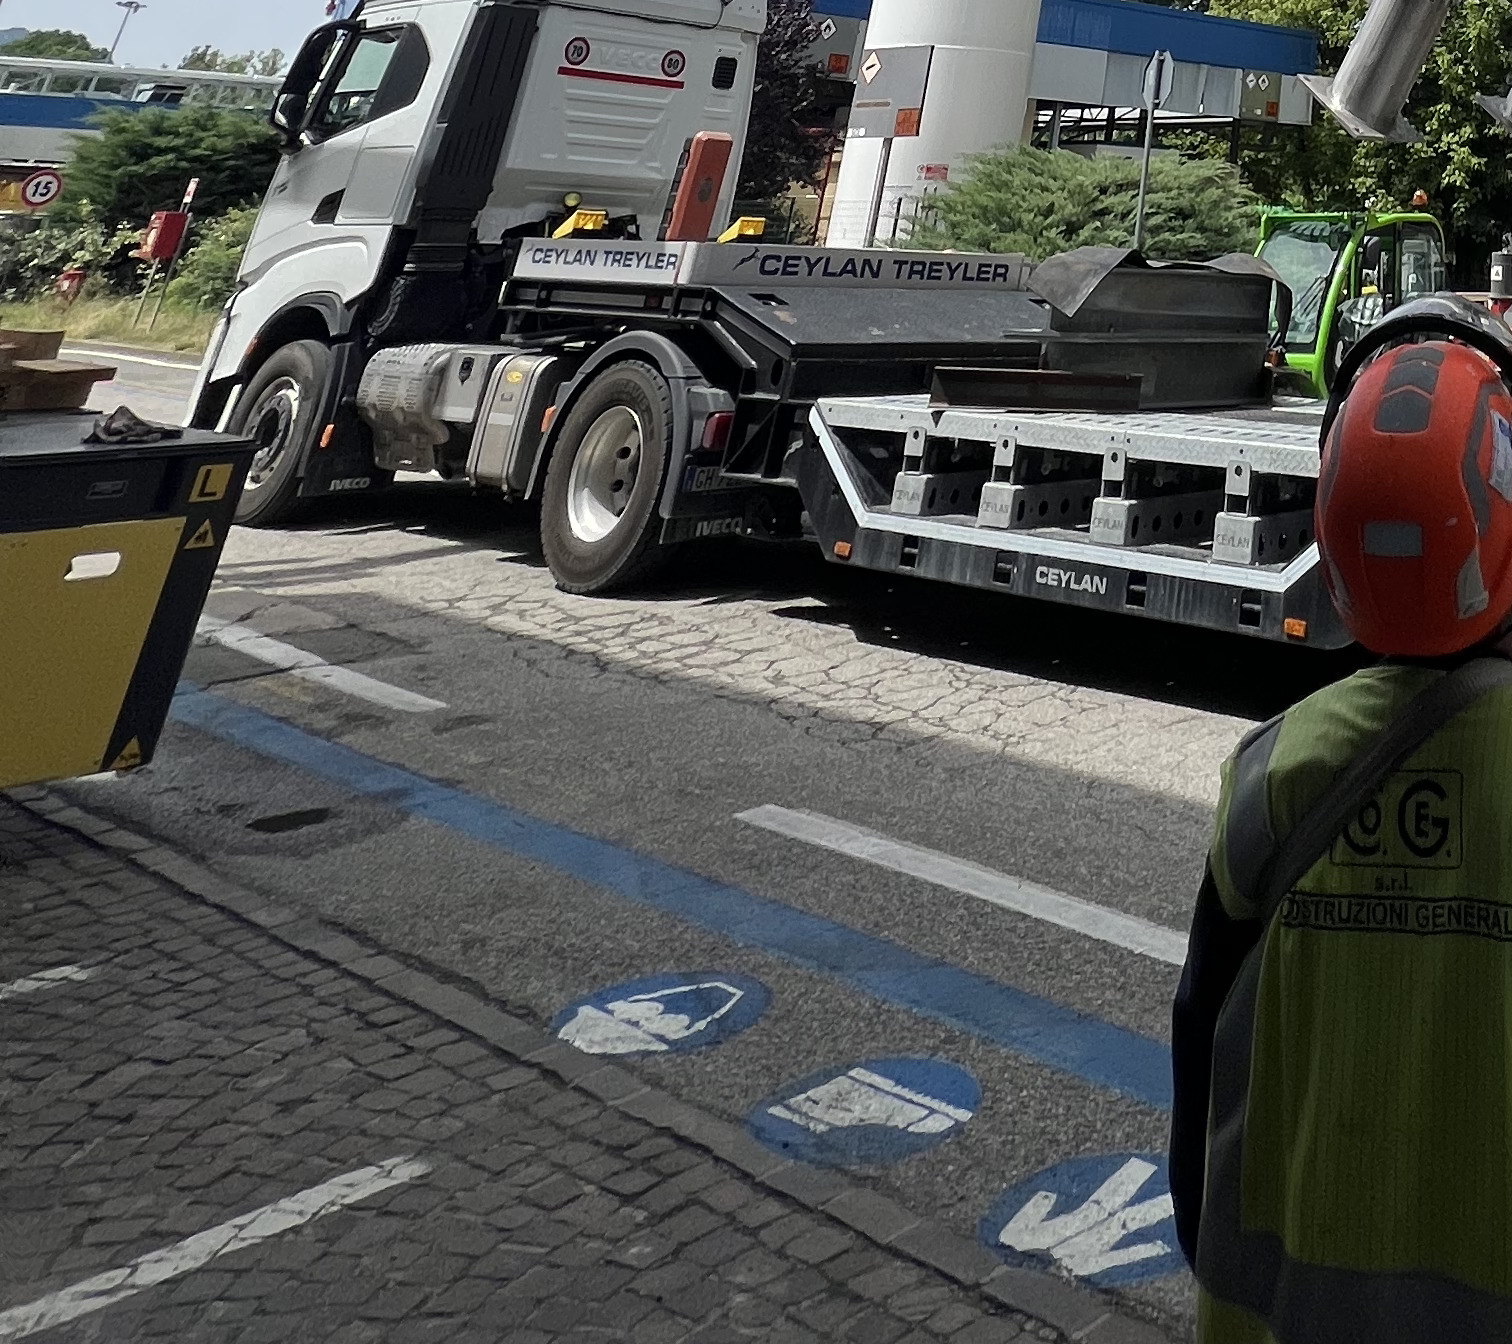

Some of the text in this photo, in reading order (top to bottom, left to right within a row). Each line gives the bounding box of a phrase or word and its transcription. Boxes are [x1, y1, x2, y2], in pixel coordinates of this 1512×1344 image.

[570, 44, 584, 58] 70
[666, 57, 680, 71] 80
[31, 180, 53, 198] 15
[531, 247, 679, 271] CEYLAN TREYLER
[758, 254, 1010, 283] CEYLAN TREYLER
[197, 468, 218, 498] L
[328, 476, 371, 491] IVECO
[695, 516, 743, 538] IVECO
[1092, 516, 1124, 531] CEYLAN
[1216, 533, 1250, 549] CEYLAN
[1035, 565, 1108, 595] CEYLAN
